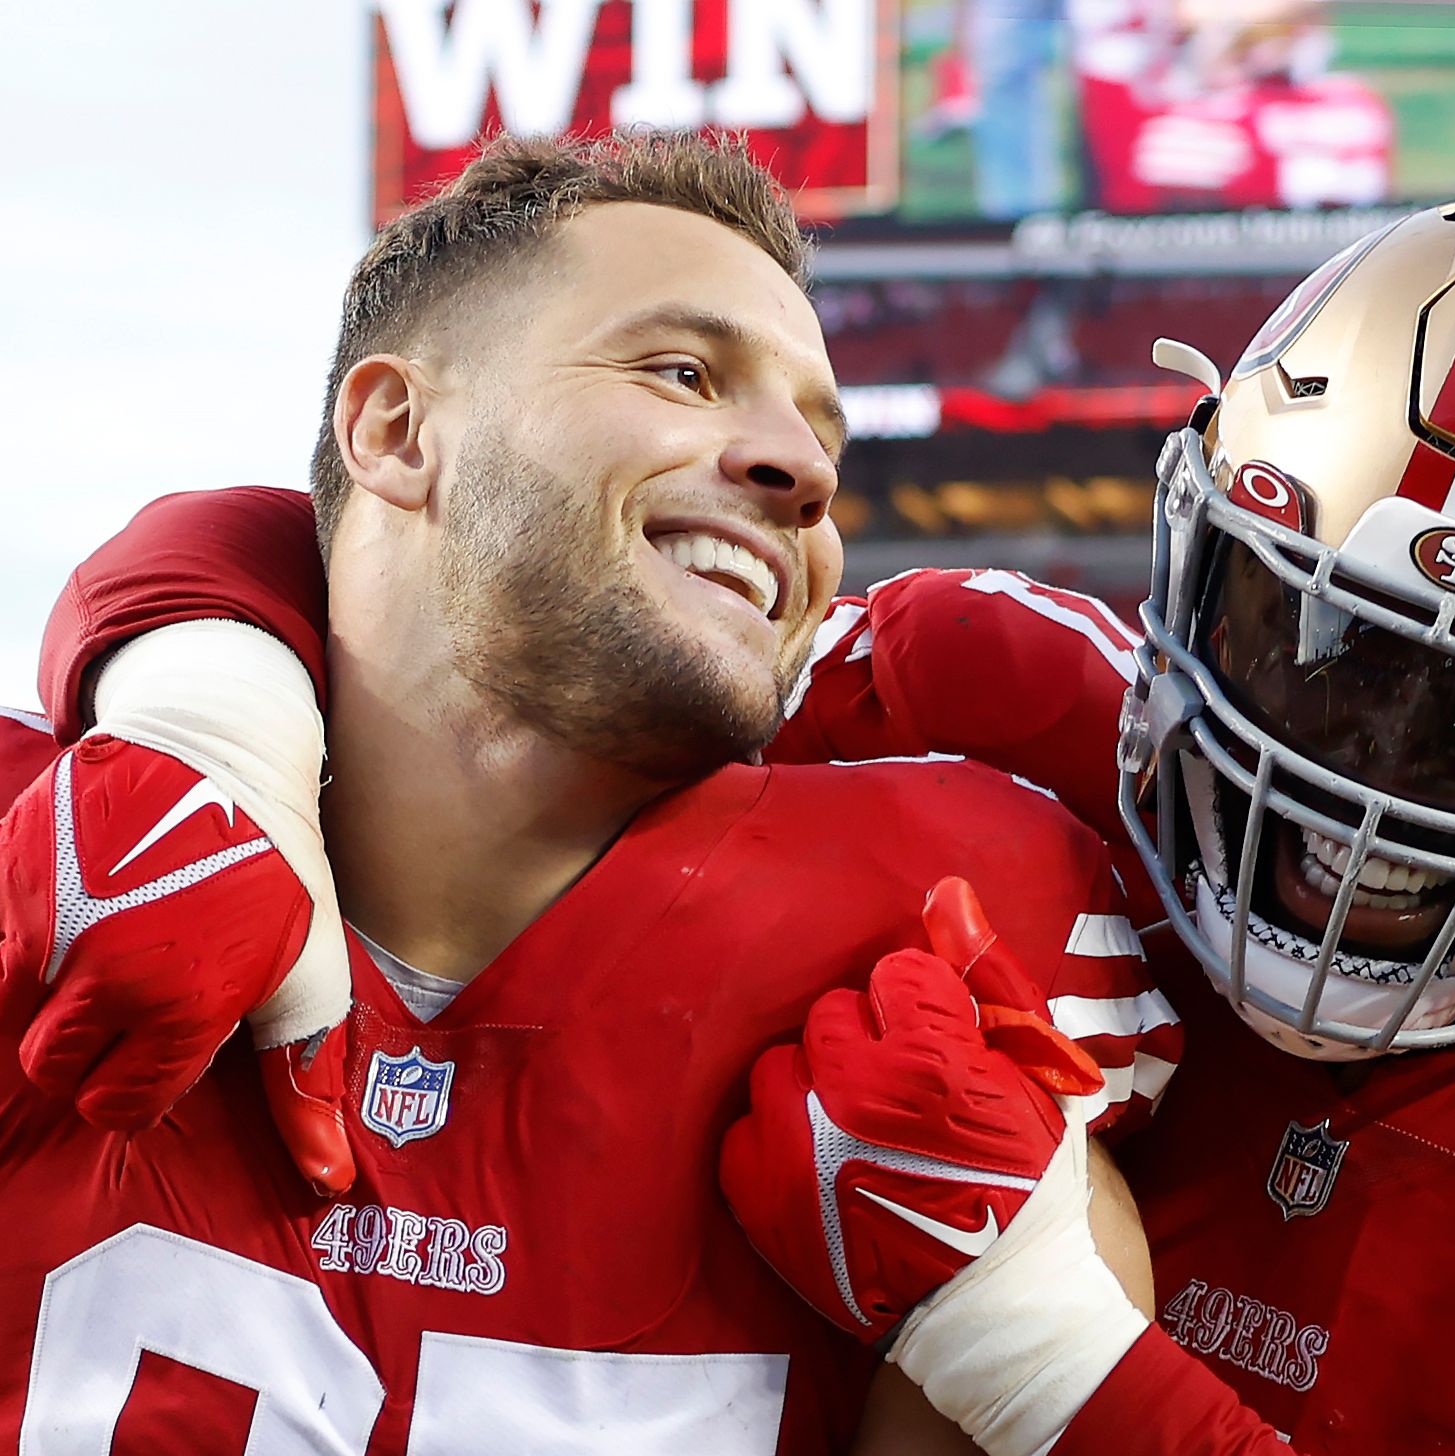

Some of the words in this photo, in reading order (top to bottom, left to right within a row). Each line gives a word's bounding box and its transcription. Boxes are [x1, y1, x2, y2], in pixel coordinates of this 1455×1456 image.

[377, 0, 874, 151] WIN
[374, 1086, 432, 1128] NFL
[1276, 1155, 1323, 1202] NFL
[309, 1202, 508, 1296] 49ERS
[1162, 1278, 1331, 1392] 49ERS
